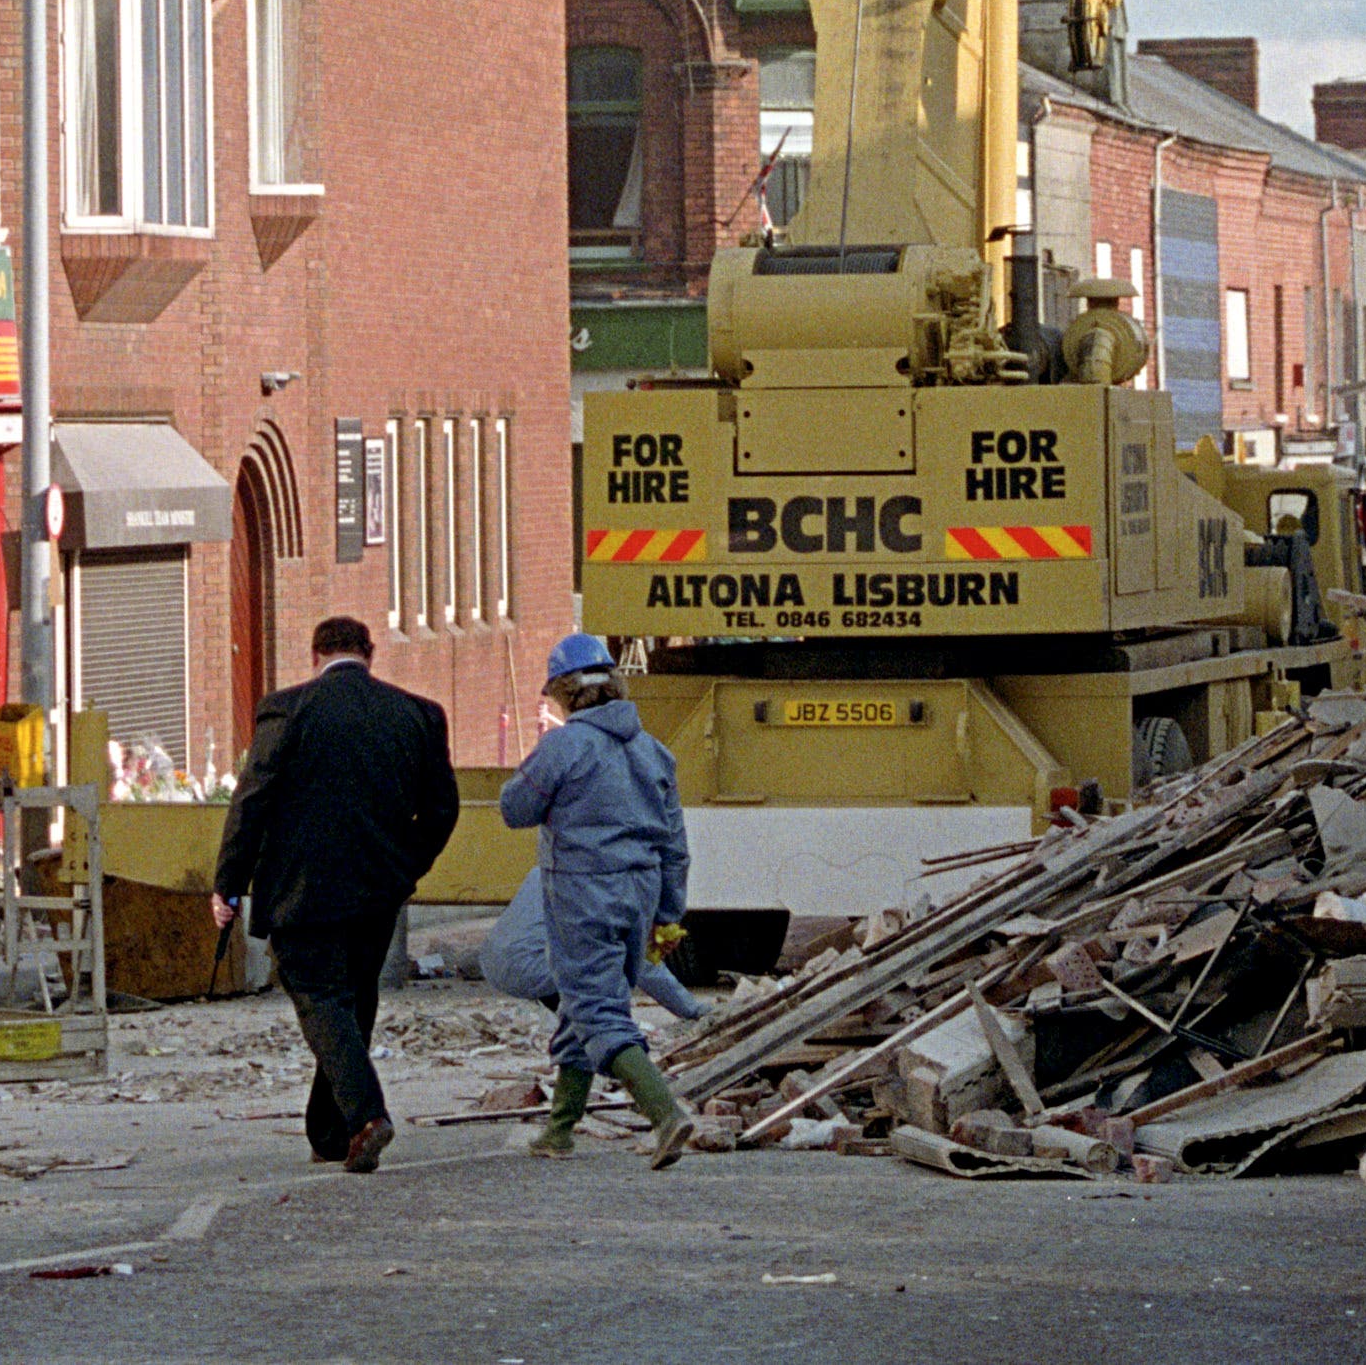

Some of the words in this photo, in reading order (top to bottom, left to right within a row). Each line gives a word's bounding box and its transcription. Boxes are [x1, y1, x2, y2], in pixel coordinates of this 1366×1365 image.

[612, 435, 683, 467] FOR
[971, 429, 1058, 464] FOR
[607, 469, 689, 503] HIRE
[965, 465, 1066, 501] HIRE
[727, 495, 923, 554] BCHC
[647, 574, 804, 608] ALTONA
[833, 572, 1020, 607] LISBURN
[723, 612, 764, 629] TEL.
[776, 611, 830, 629] 0846
[841, 611, 922, 629] 682434
[788, 701, 831, 723] JBZ
[835, 701, 893, 723] 5506
